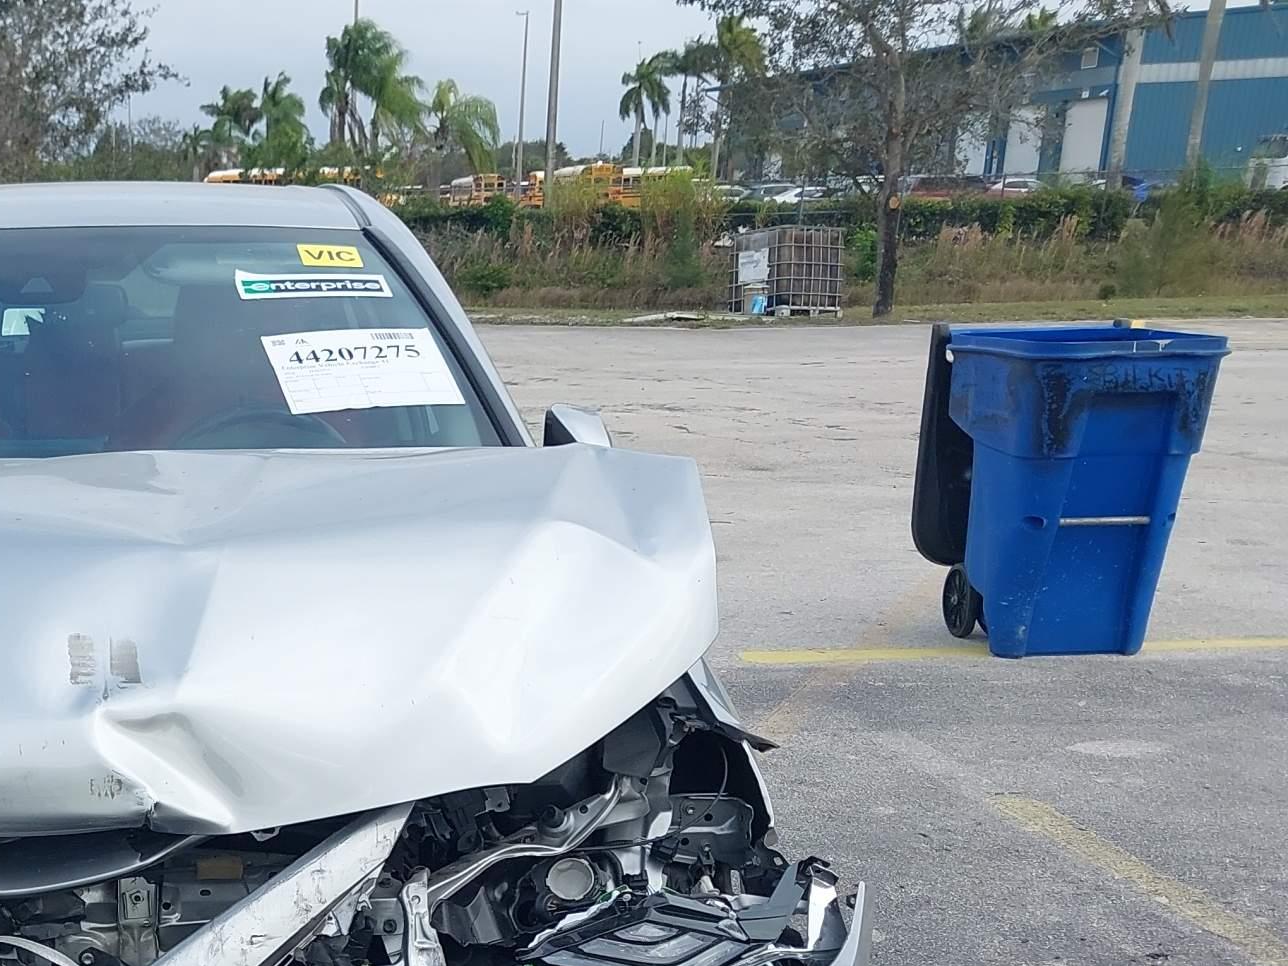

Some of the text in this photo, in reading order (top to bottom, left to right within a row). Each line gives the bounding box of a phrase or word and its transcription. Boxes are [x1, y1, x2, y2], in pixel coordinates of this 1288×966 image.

[304, 249, 356, 262] VIC
[246, 280, 381, 291] enterprise
[288, 344, 420, 365] 44207275
